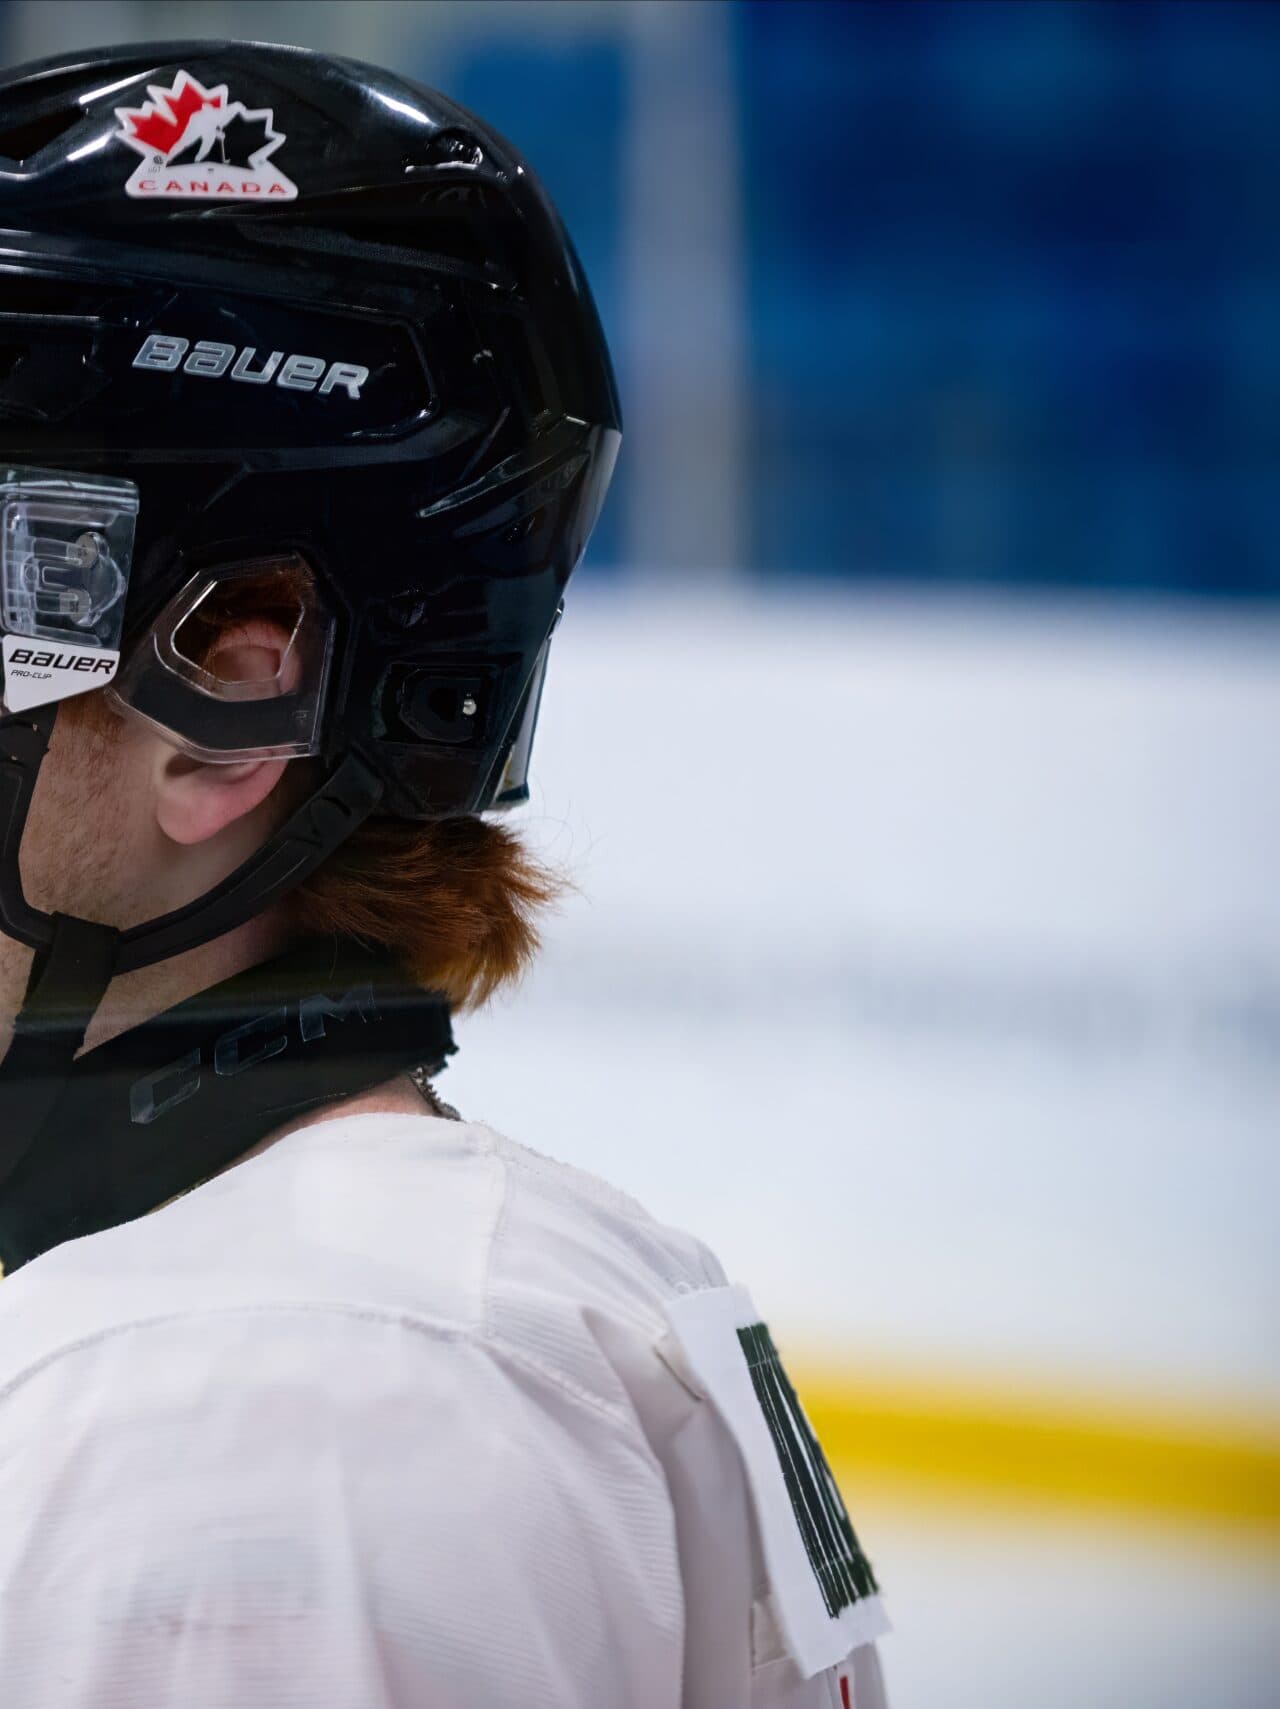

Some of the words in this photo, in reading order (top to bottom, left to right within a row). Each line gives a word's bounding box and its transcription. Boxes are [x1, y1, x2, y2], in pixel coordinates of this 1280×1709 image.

[138, 180, 288, 194] CANADA
[132, 334, 370, 400] BAUER
[8, 648, 116, 675] BAUER
[10, 669, 52, 680] PRO-CLIP
[130, 982, 384, 1125] CCM
